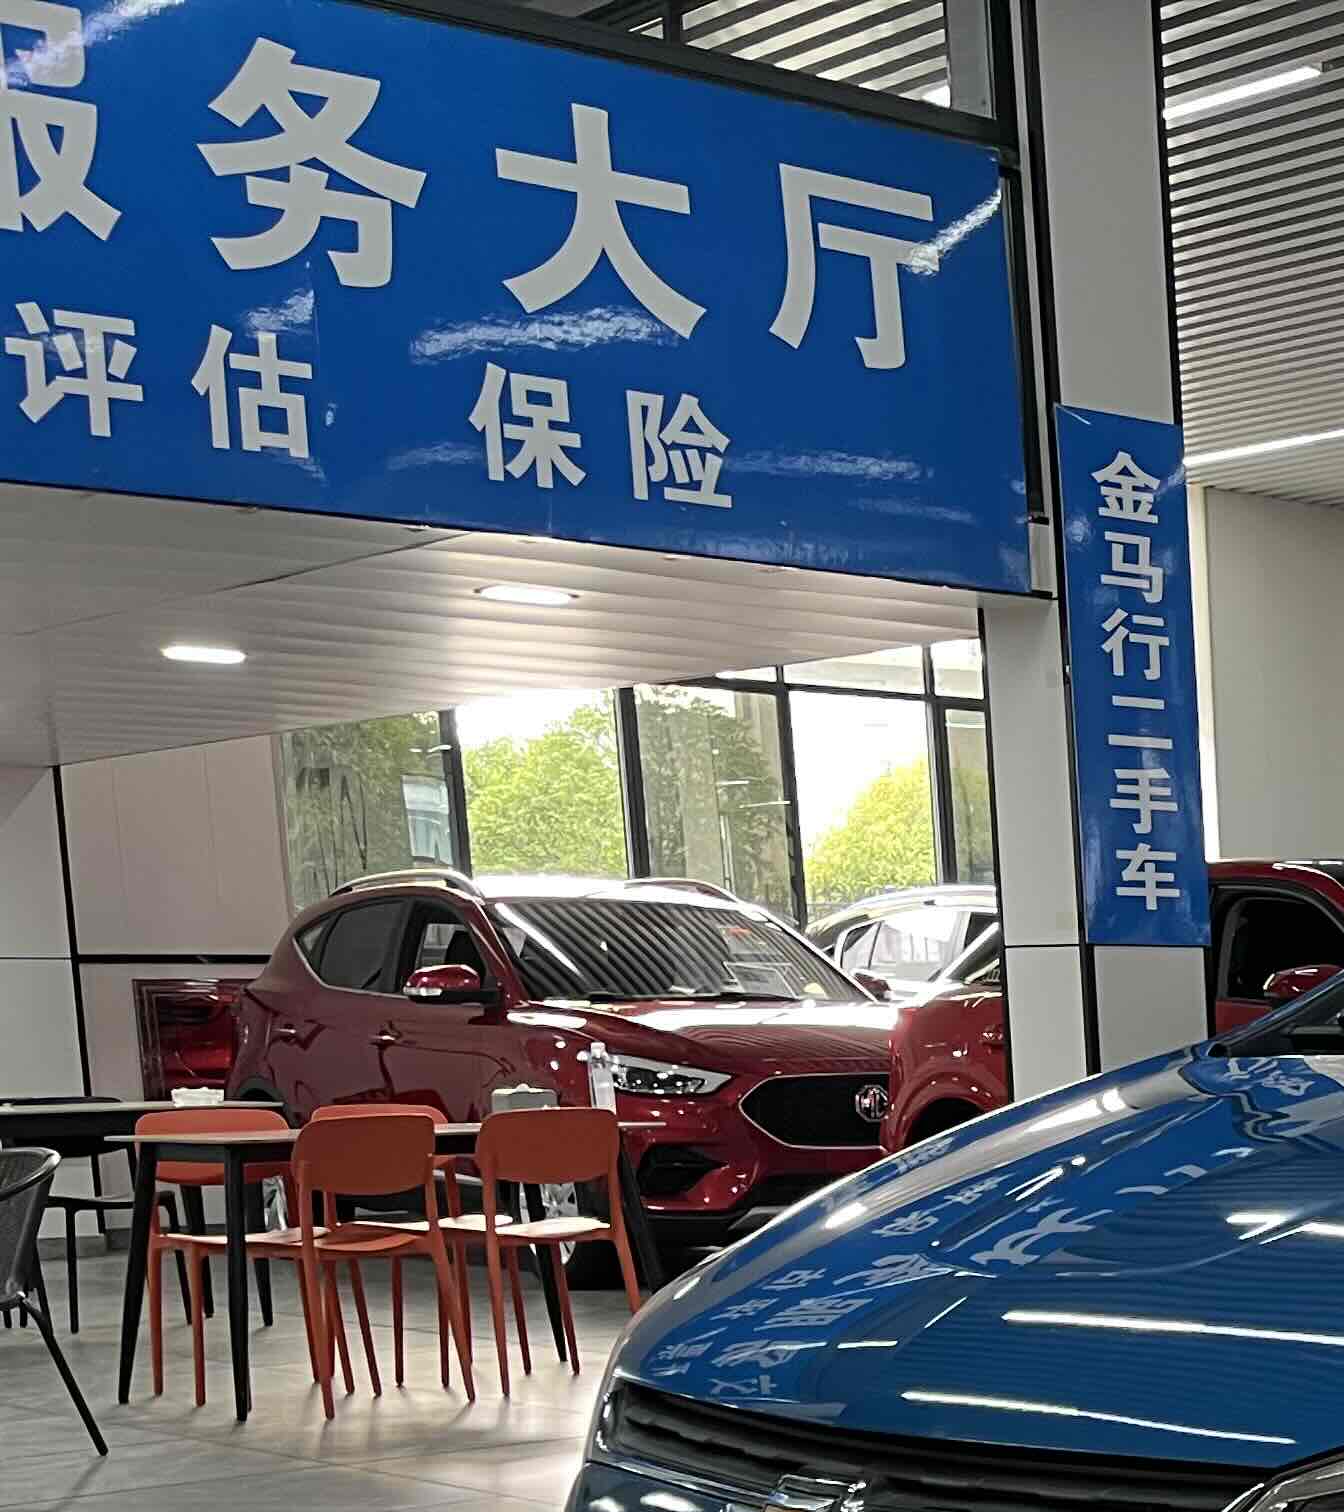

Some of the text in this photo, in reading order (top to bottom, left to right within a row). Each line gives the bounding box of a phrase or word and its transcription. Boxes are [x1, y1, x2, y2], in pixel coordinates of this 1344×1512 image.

[4, 301, 734, 510] 评估 保险
[1091, 450, 1181, 911] 金马行二手车
